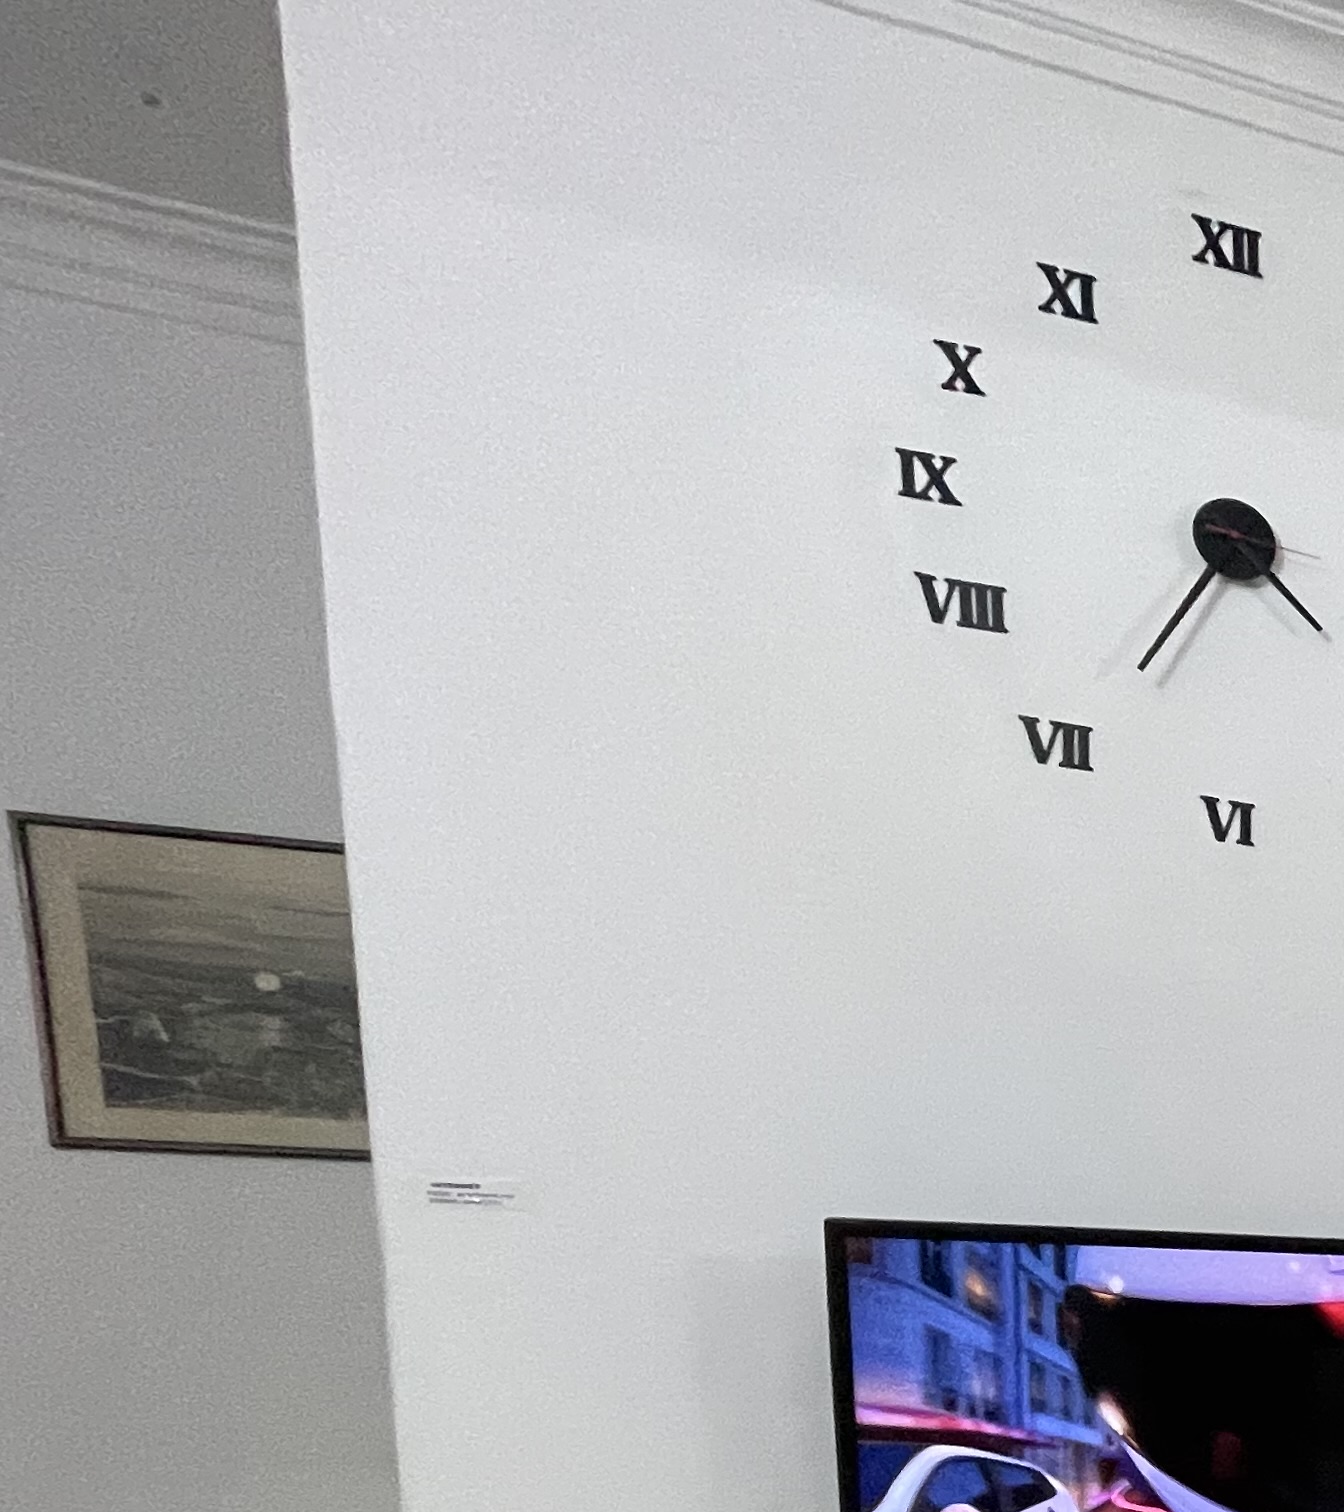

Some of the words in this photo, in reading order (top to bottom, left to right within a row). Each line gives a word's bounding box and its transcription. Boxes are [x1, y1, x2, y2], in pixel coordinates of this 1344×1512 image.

[1191, 214, 1263, 279] XII
[1037, 262, 1098, 324] XI
[933, 339, 985, 397] X
[895, 448, 962, 506] IX
[914, 572, 1009, 633] VIII
[1019, 715, 1093, 771] VII
[1200, 796, 1255, 846] VI
